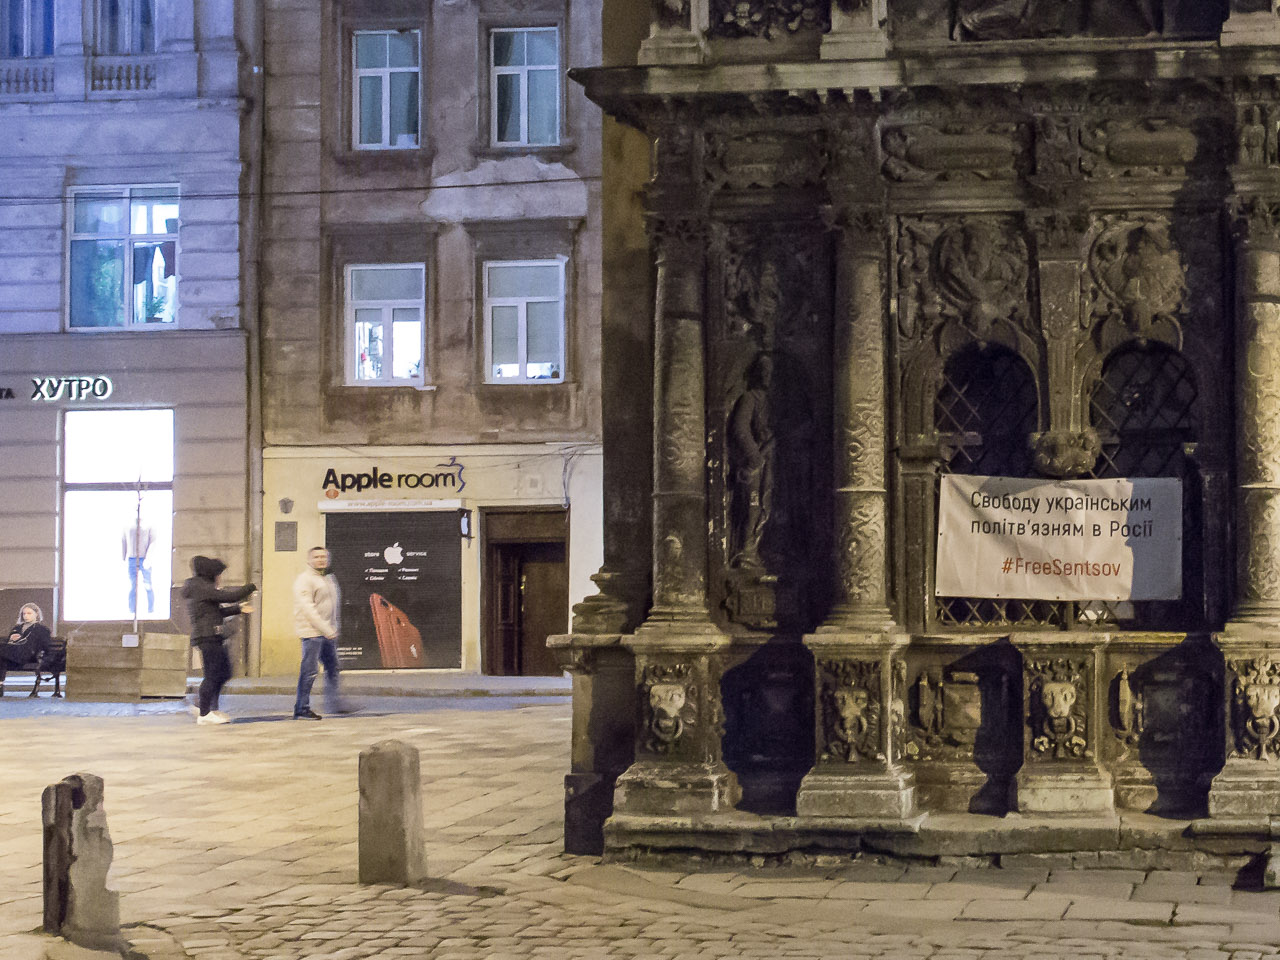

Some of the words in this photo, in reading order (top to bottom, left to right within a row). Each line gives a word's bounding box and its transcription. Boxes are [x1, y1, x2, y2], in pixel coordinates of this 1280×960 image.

[31, 376, 112, 400] ХУТРО
[322, 467, 393, 492] Apple
[398, 473, 455, 488] room
[971, 491, 1040, 513] Свободу
[1046, 494, 1151, 514] українським
[971, 519, 1084, 537] політв'язням
[1092, 524, 1102, 537] в
[1110, 520, 1154, 538] Росії
[1002, 557, 1121, 577] #FreeSentsov
